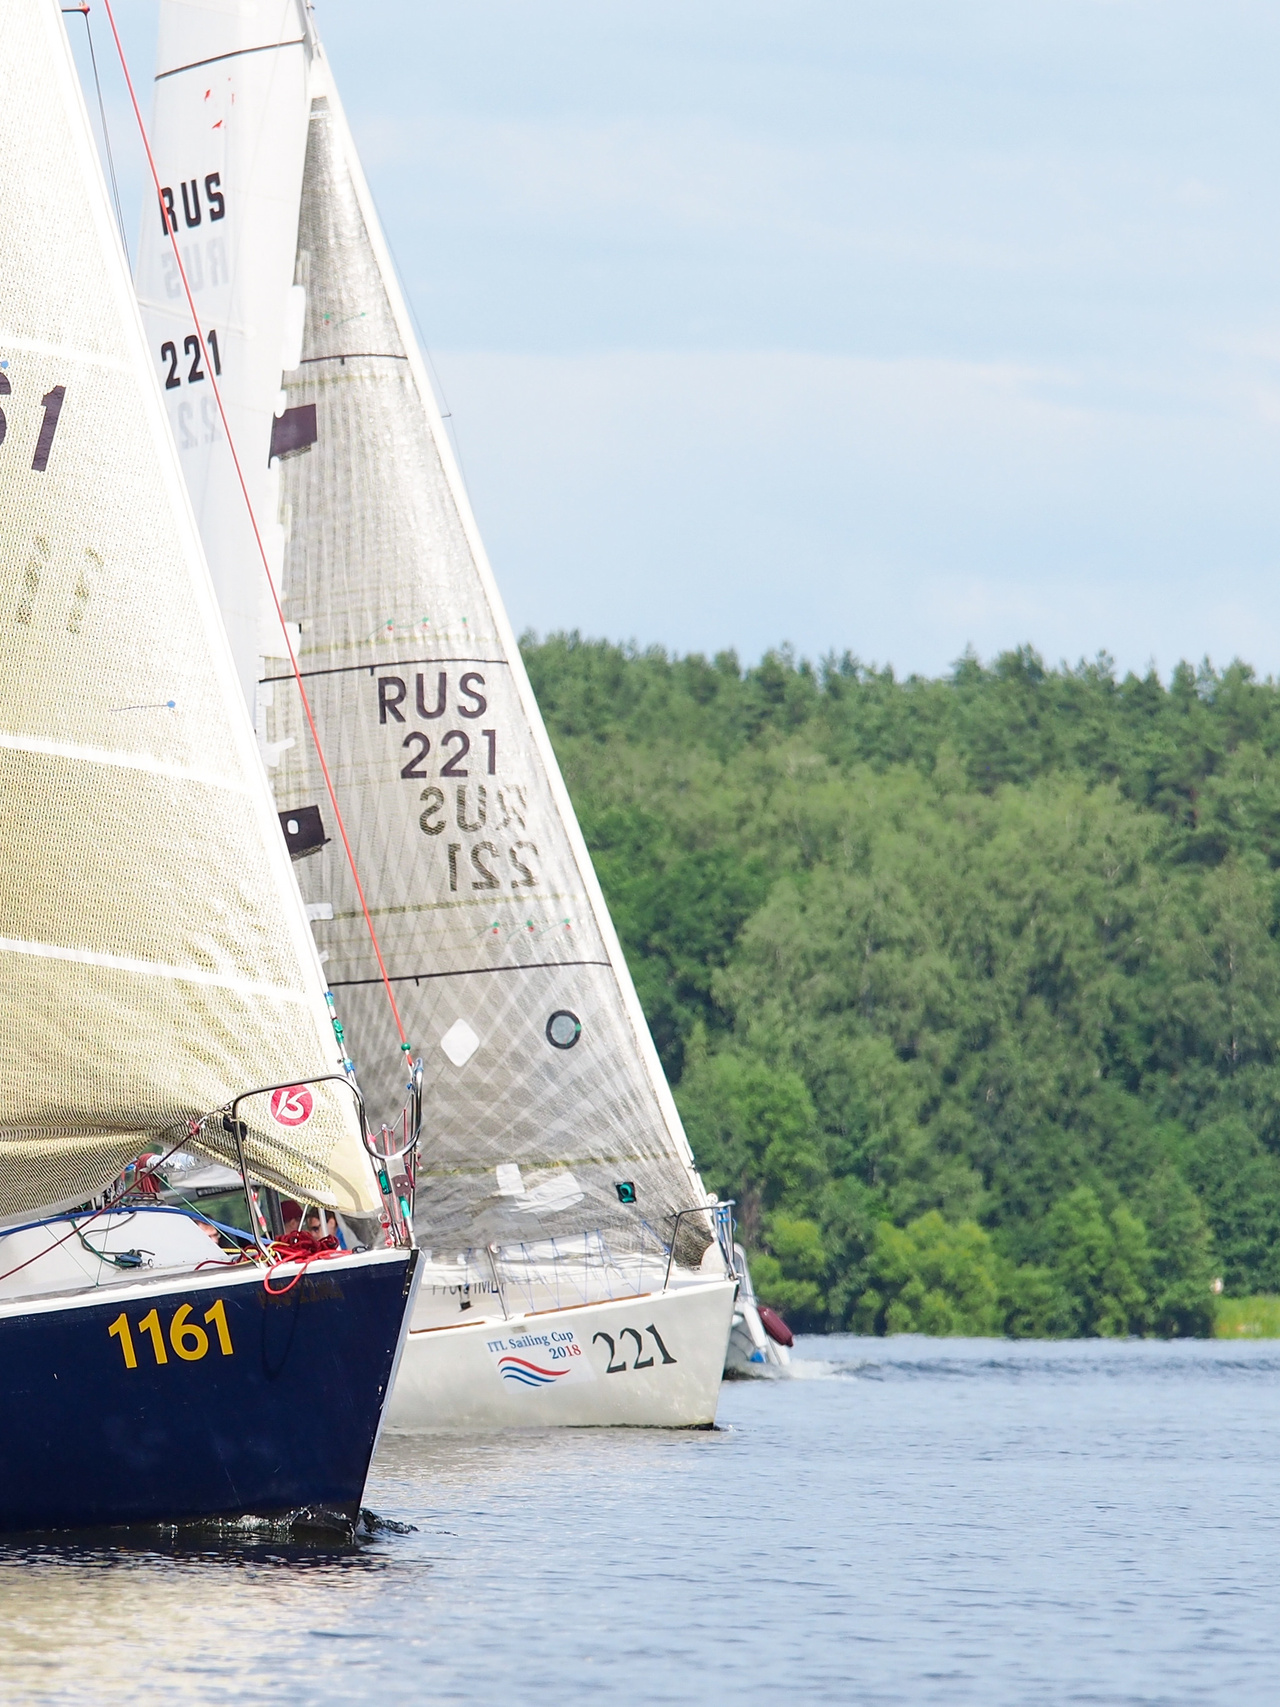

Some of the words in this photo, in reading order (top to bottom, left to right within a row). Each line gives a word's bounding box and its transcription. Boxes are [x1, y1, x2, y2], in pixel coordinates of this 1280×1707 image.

[158, 172, 225, 236] RUS
[161, 329, 221, 390] 221
[377, 672, 487, 724] RUS
[400, 729, 496, 779] 221
[108, 1299, 233, 1369] 1161
[487, 1340, 508, 1353] ITL
[509, 1335, 551, 1350] Sailing
[551, 1331, 574, 1343] Cup
[549, 1344, 582, 1359] 2018
[592, 1324, 677, 1374] 221
